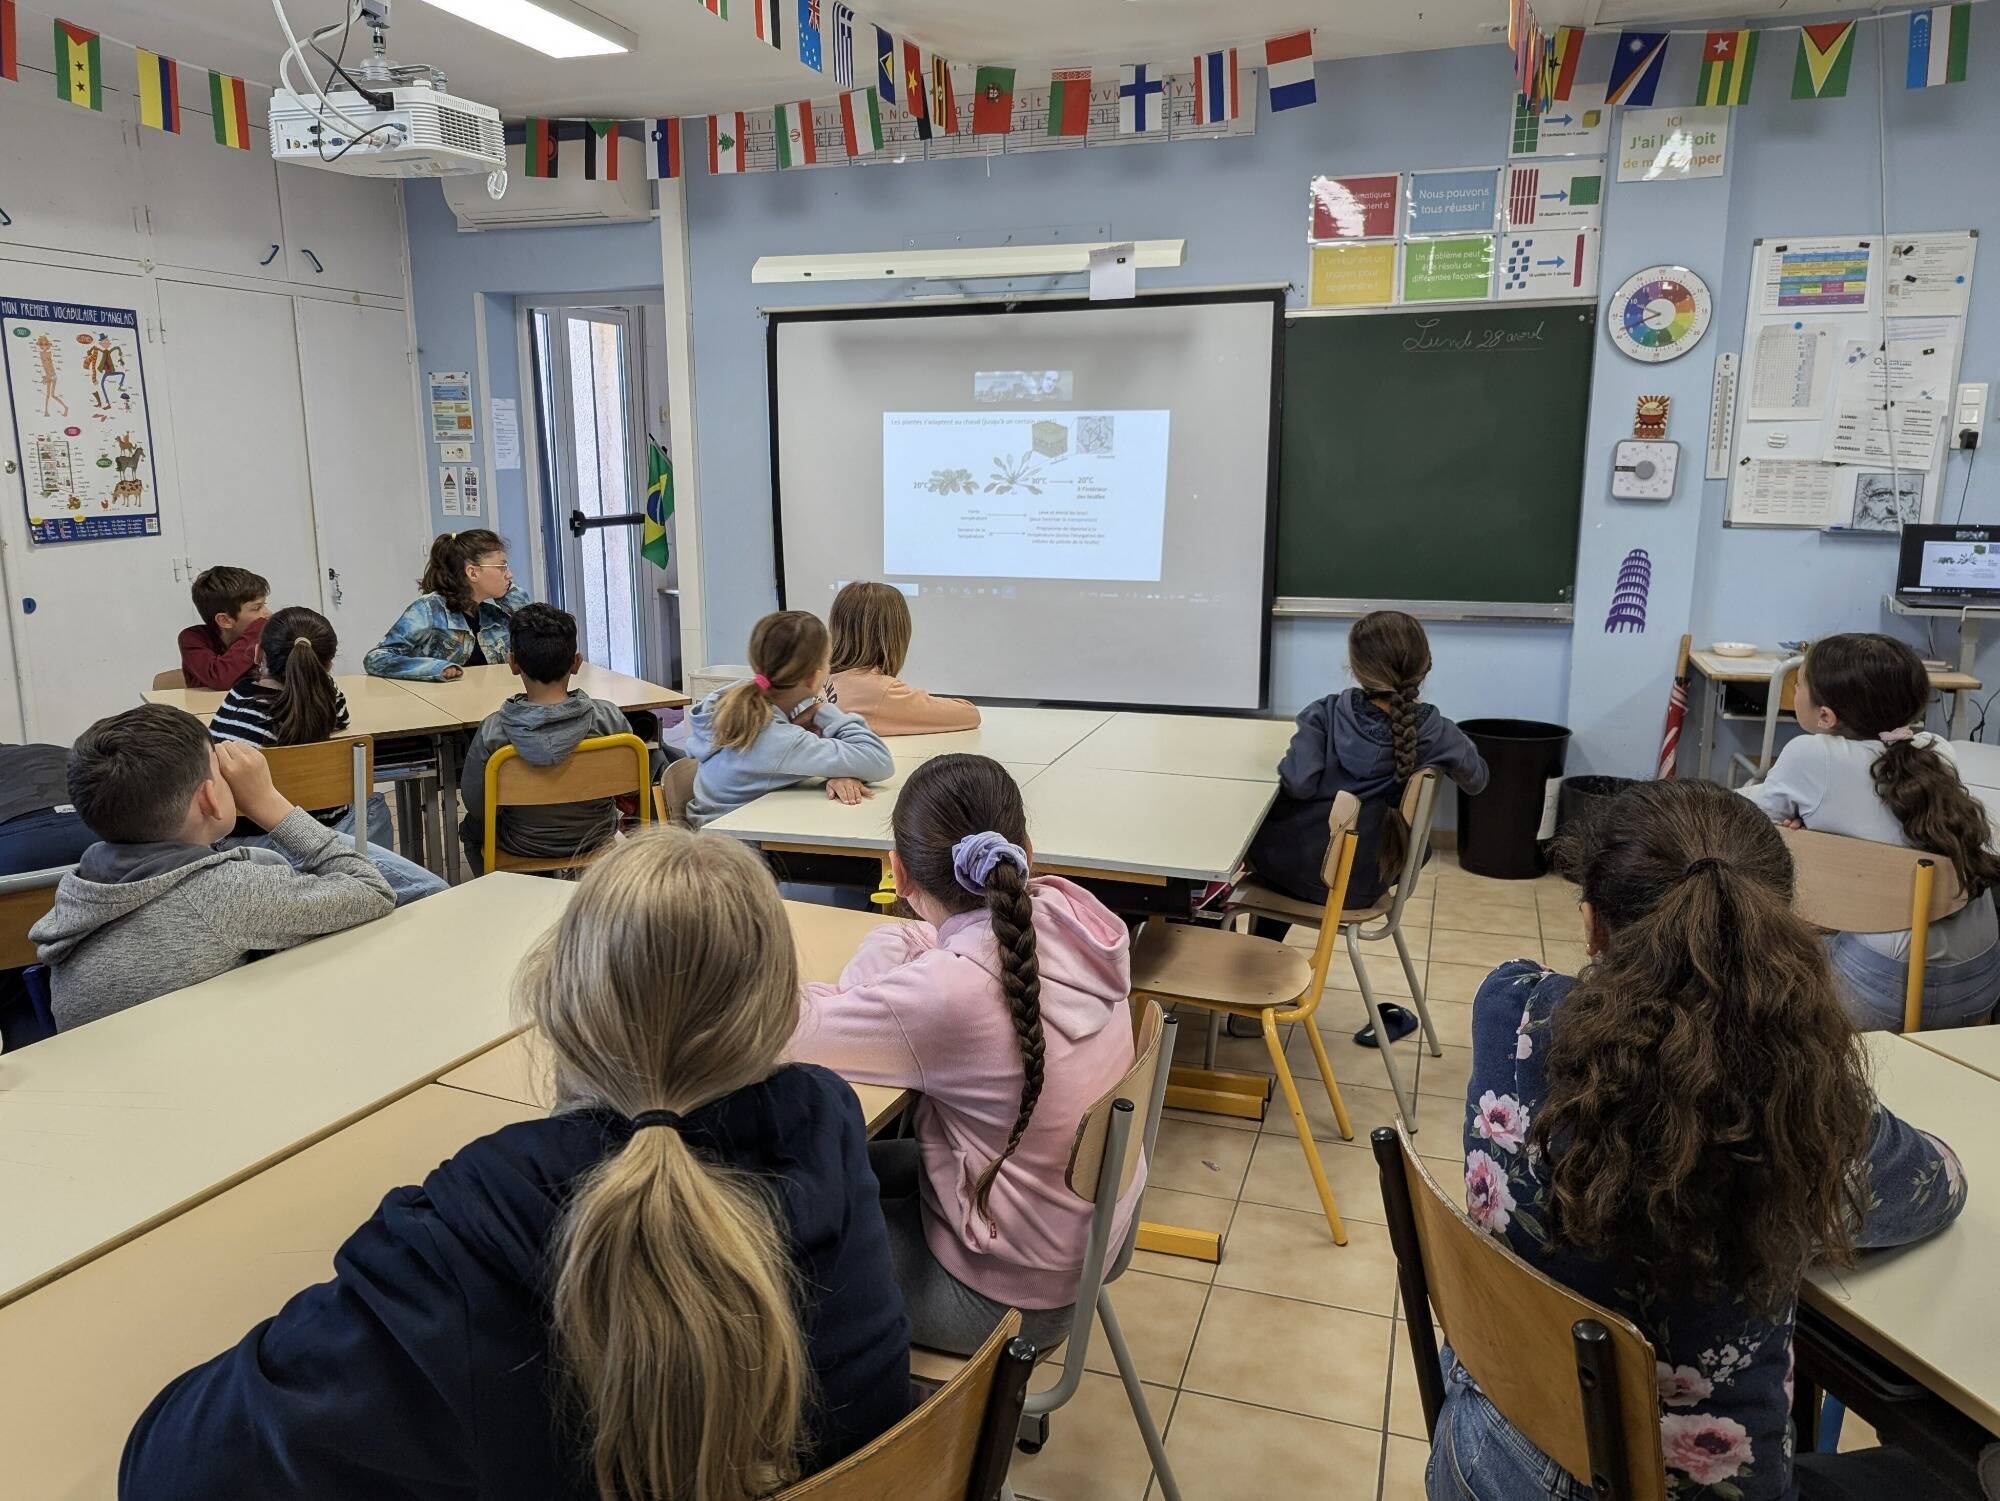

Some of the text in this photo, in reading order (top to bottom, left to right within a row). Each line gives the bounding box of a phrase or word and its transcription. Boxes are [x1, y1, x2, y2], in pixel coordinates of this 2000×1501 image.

[1667, 116, 1682, 127] ICI
[1630, 135, 1655, 149] J'ai
[1623, 158, 1638, 168] de
[1420, 187, 1489, 200] Nous pouvons
[1421, 205, 1442, 214] tous
[1444, 202, 1480, 213] réussir
[1415, 253, 1426, 261] Un
[1463, 261, 1473, 269] de
[1, 301, 135, 326] MON PREMIER VOCABULAIRE D'ANGLAIS
[1475, 329, 1505, 349] 28
[1506, 321, 1545, 343] avril
